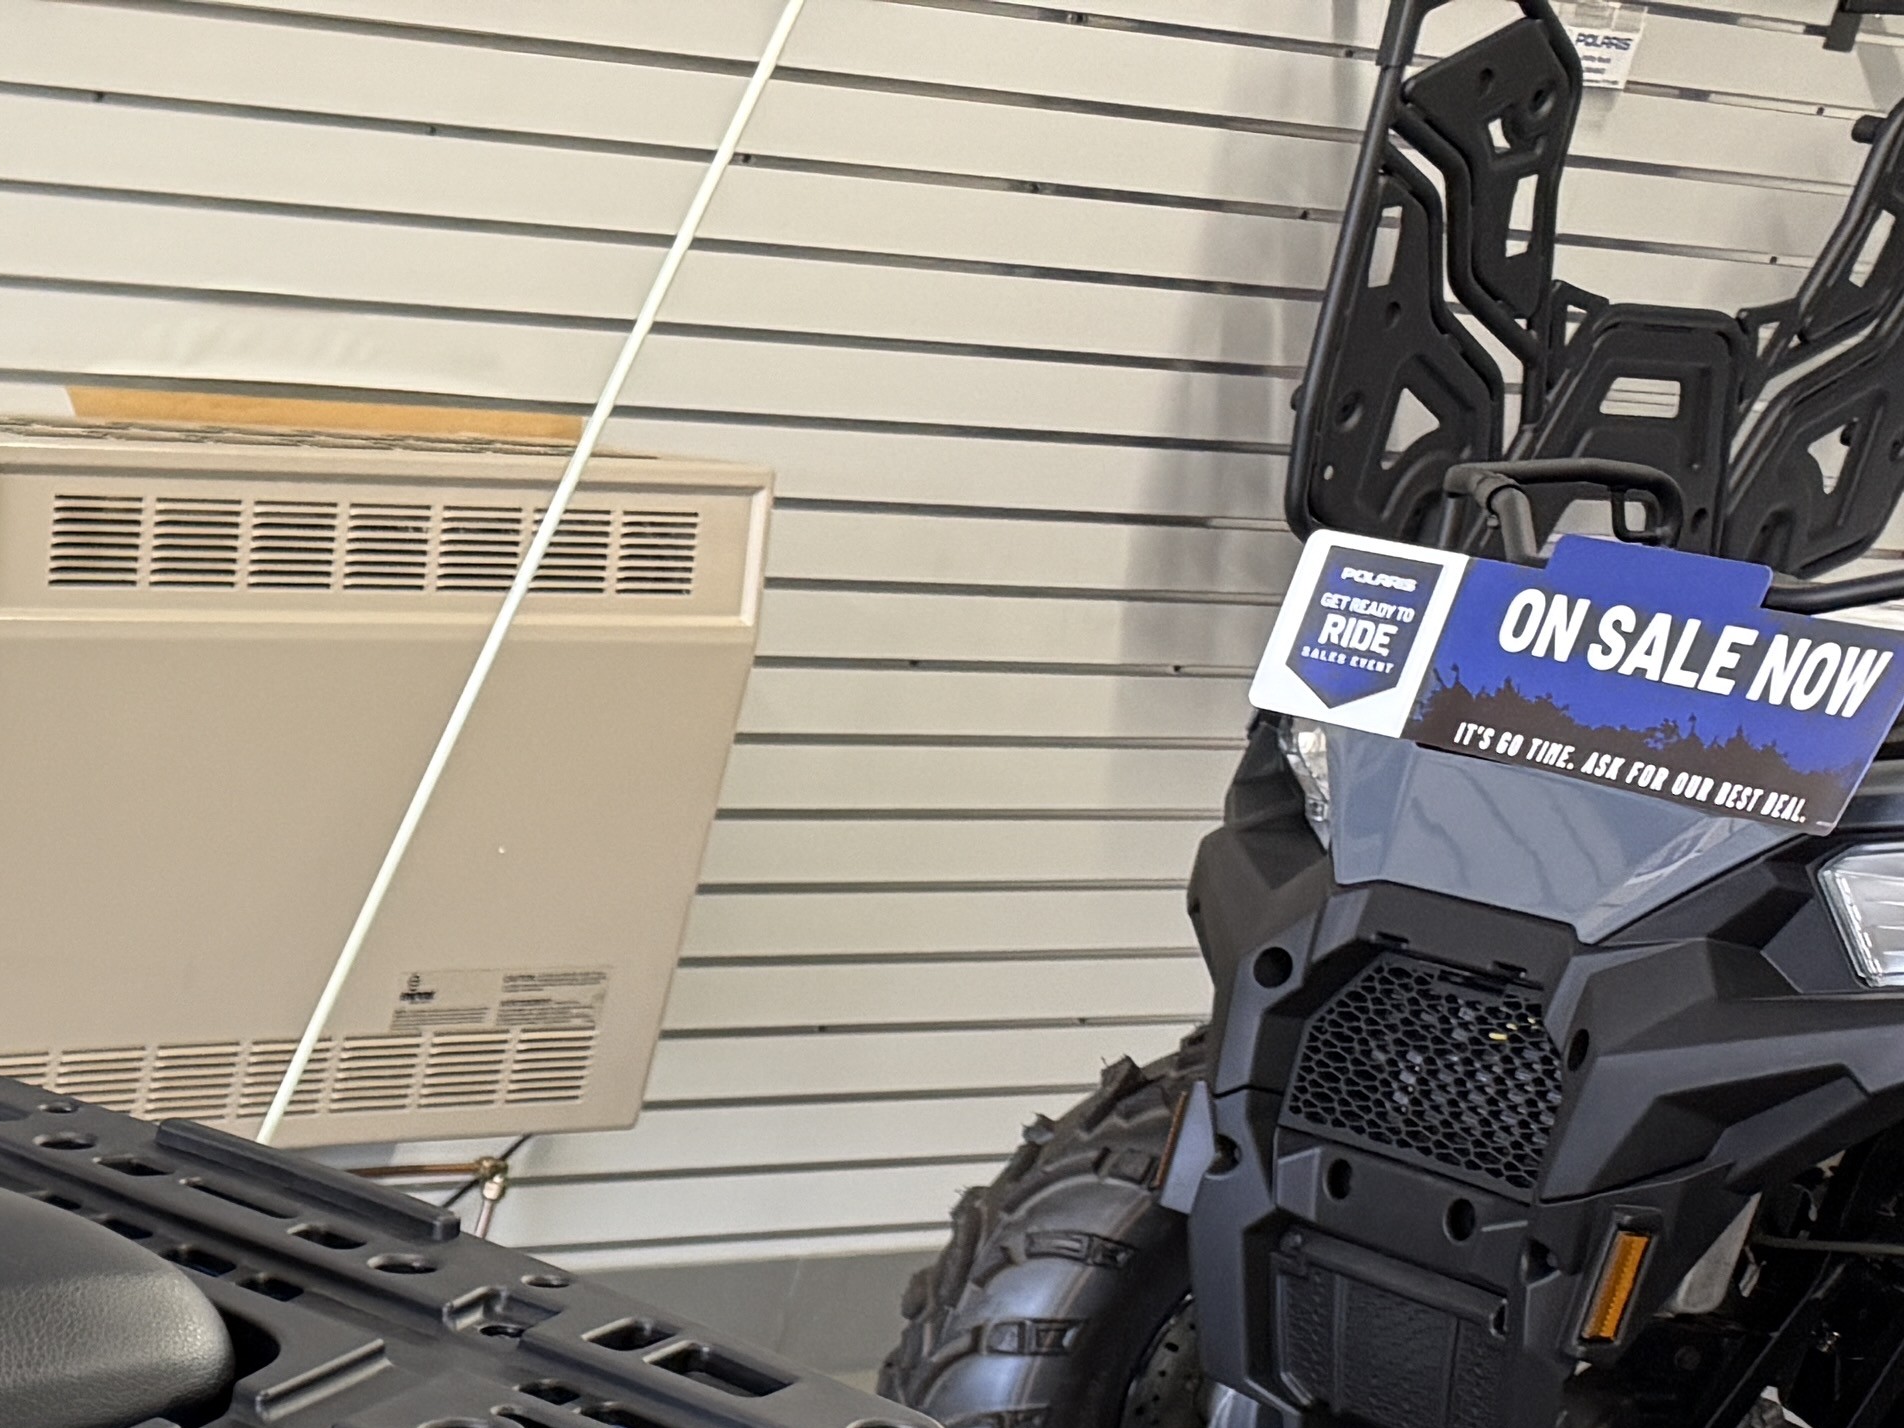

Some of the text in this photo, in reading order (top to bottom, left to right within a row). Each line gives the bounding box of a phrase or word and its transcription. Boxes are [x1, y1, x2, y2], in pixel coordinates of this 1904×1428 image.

[1340, 566, 1418, 593] POLARIS
[1320, 592, 1415, 622] GET READY TO
[1318, 615, 1399, 656] RIDE
[1300, 645, 1394, 674] SALES EVENT
[1498, 588, 1892, 719] ON SALE NOW
[1453, 721, 1807, 824] IT'S GO TIME. ASK FOR OUR BEST DEAL.
